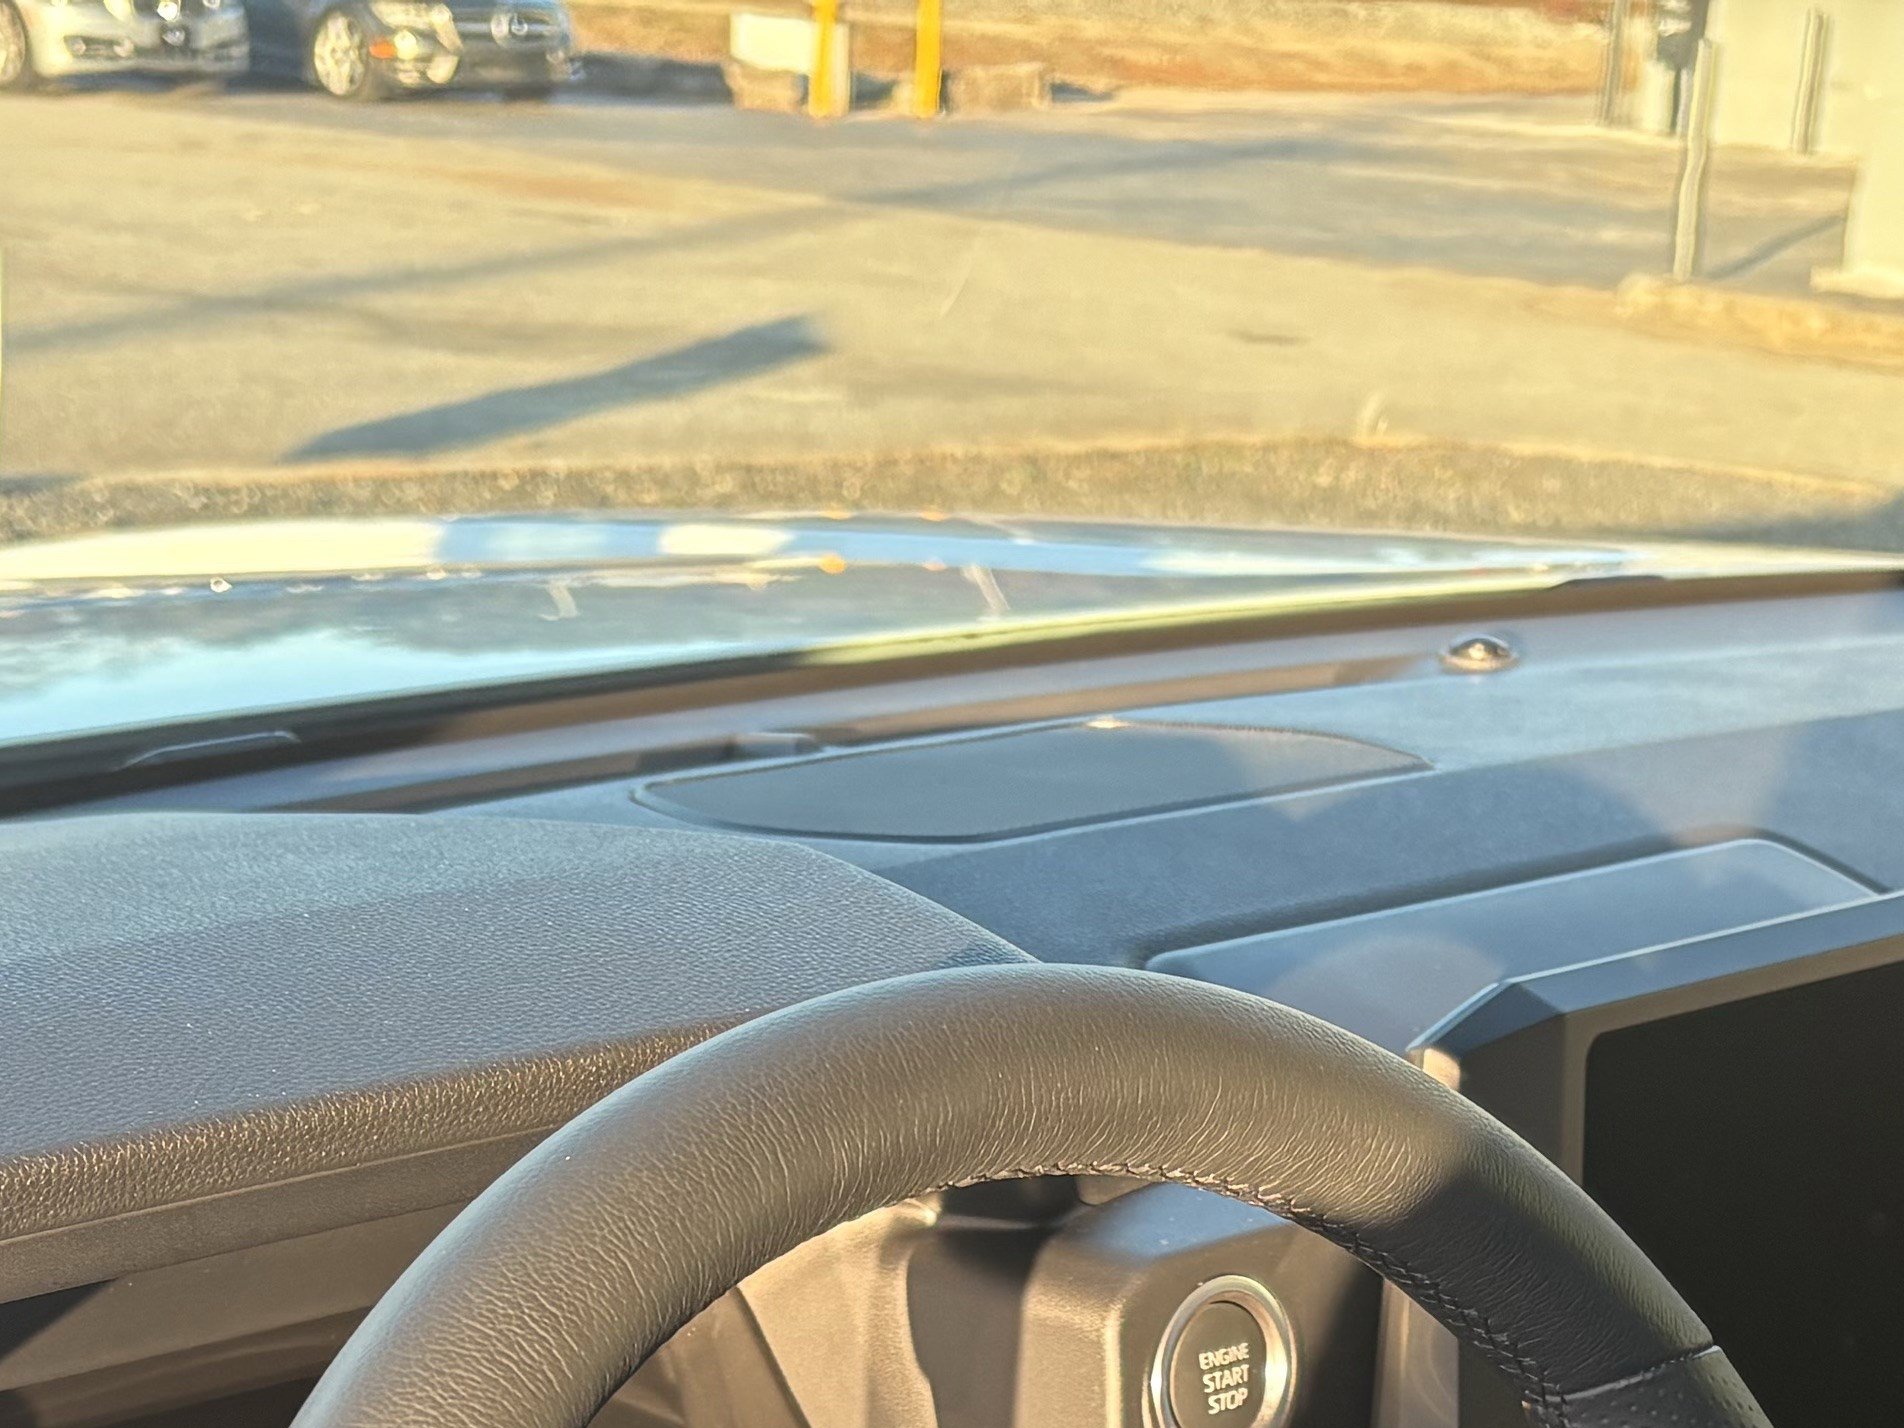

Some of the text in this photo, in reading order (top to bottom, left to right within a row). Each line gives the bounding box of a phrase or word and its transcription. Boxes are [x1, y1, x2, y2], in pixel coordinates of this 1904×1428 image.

[1199, 1342, 1250, 1370] ENGINE
[1202, 1364, 1249, 1393] START
[1208, 1388, 1248, 1415] STOP
